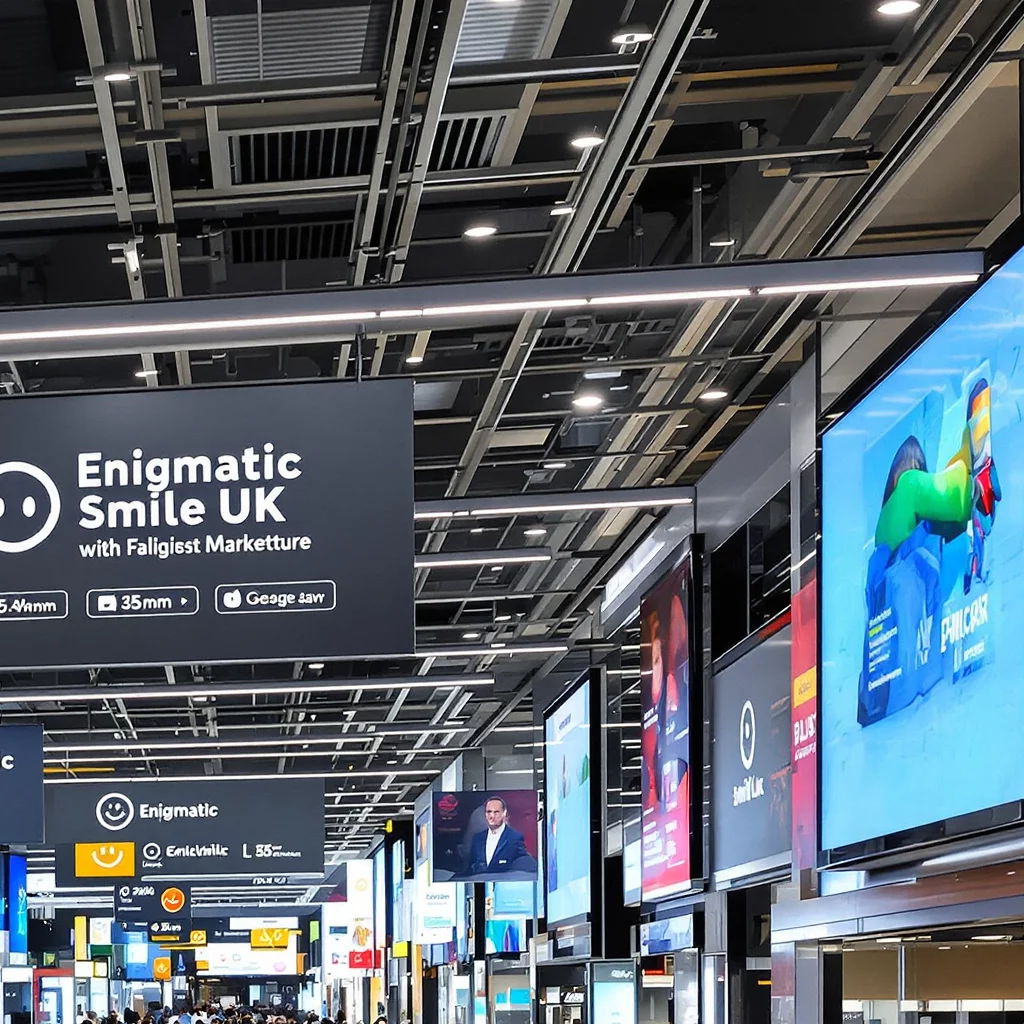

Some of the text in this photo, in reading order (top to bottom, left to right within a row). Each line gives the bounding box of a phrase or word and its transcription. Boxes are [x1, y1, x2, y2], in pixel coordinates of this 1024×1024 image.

[78, 442, 303, 493] Enigmatic
[79, 485, 287, 529] Smile UK
[79, 537, 121, 558] with
[121, 594, 172, 610] 35mm
[139, 802, 219, 822] Enigmatic
